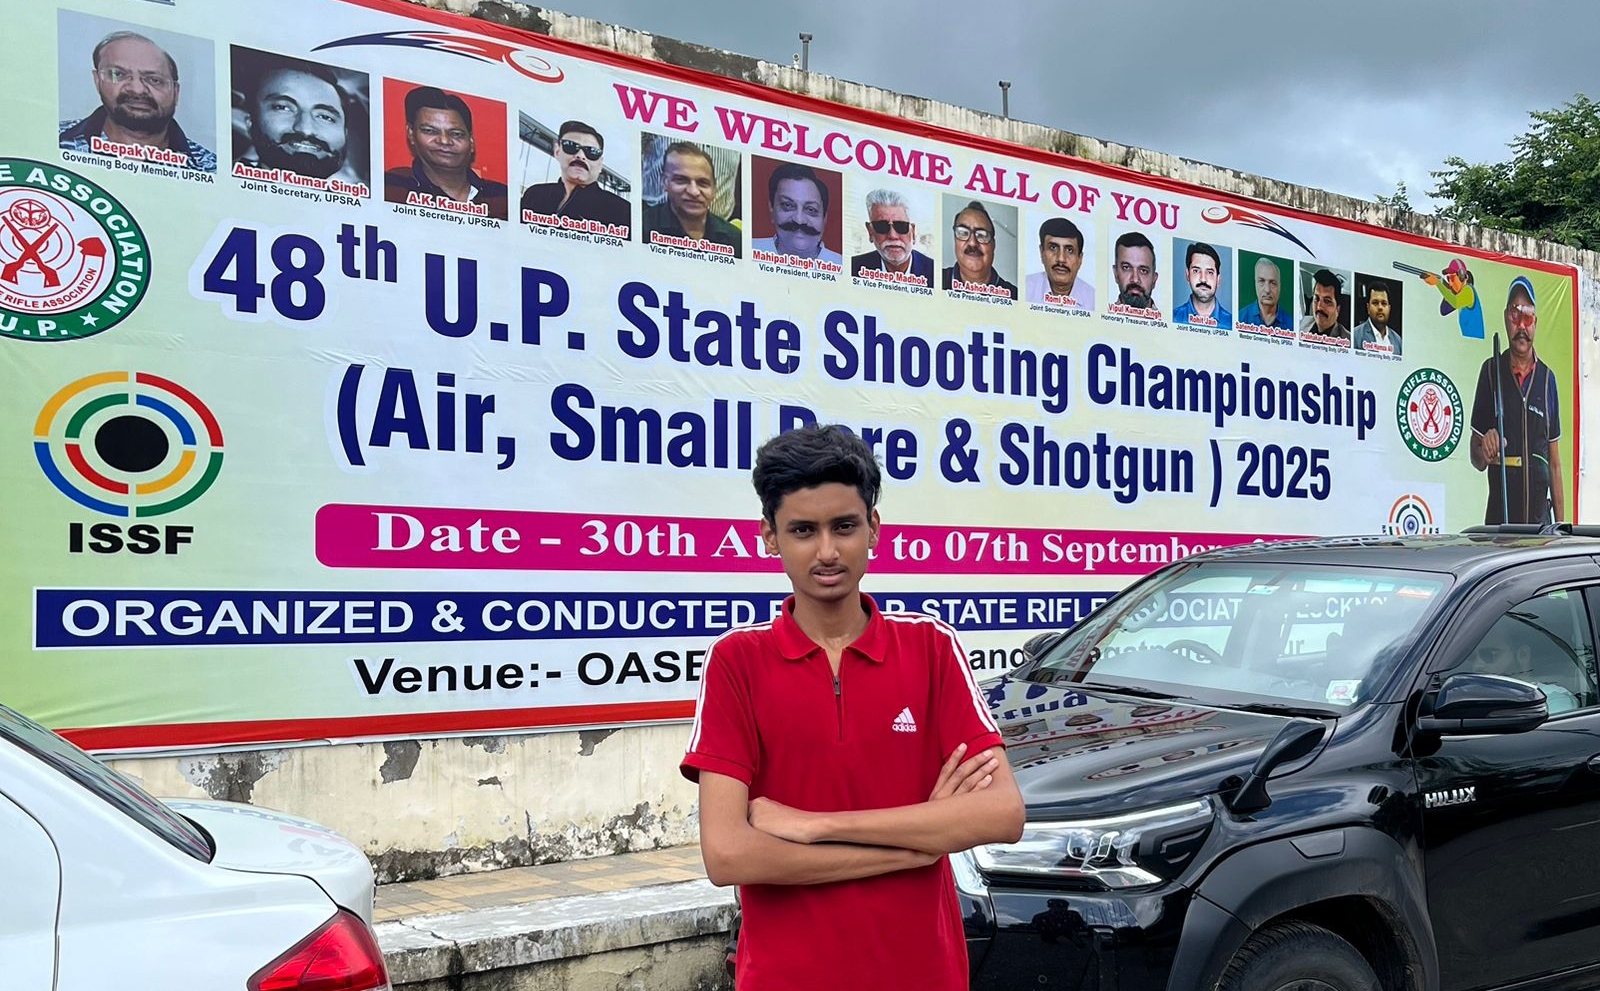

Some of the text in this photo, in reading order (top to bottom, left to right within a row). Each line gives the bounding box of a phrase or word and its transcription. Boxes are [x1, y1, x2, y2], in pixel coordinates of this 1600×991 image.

[93, 138, 186, 164] Deepak Yadav
[613, 83, 1180, 230] WE WELCOME ALL OF YOU
[62, 151, 214, 184] Governing Body Member, UPSRA
[234, 164, 368, 196] Anand Kumar Singh
[240, 181, 361, 207] Joint Secretary, UPSRA
[408, 192, 487, 215] A.K. Kaushal
[393, 204, 501, 229] Joint Secretary, UPSRA
[524, 211, 627, 236] Nawab Saad Bin Asif
[25, 167, 143, 315] ASSOCIATION
[529, 225, 624, 247] Vice President, UPSRA
[652, 232, 733, 254] Ramendra Sharma
[650, 245, 735, 265] Vice President, UPSRA
[753, 250, 841, 273] Mahipal Singh Yadav
[759, 263, 837, 282] Vice President, UPSRA
[860, 268, 926, 285] Jagdeep Madhok
[5, 268, 98, 308] RIFLE ASSOCIATION
[863, 279, 877, 288] Vice
[910, 287, 933, 296] UPSRA
[947, 290, 961, 299] Vice
[991, 297, 1013, 306] UPSRA
[953, 280, 1010, 296] Dr. Ashok Raina
[1071, 309, 1091, 318] UPSRA
[1101, 314, 1124, 324] Honorary
[1150, 320, 1168, 329] UPSRA
[1125, 305, 1145, 315] Kumar
[1145, 308, 1162, 319] Singh
[0, 314, 68, 337] U.P.
[203, 223, 1376, 440] 48th U.P. State Shooting Championship
[1212, 329, 1229, 337] UPSRA
[1403, 371, 1427, 397] RIFLE
[1399, 398, 1412, 440] STATE
[1429, 372, 1462, 445] ASSOCIATION
[337, 363, 515, 470] (Air,
[550, 383, 752, 471] Small
[940, 418, 980, 483] &
[999, 422, 1194, 504] Shotgun
[1236, 442, 1331, 500] 2025
[1421, 448, 1442, 459] U.P.
[69, 522, 194, 554] ISSF
[371, 512, 520, 553] Date
[580, 519, 697, 557] 30th
[892, 531, 931, 561] to
[945, 530, 1030, 561] 07th
[62, 599, 414, 636] ORGANIZED
[431, 599, 465, 633] &
[481, 599, 756, 632] CONDUCTED
[921, 598, 1017, 624] STATE
[892, 723, 917, 732] adidas
[1425, 786, 1476, 808] HILUX
